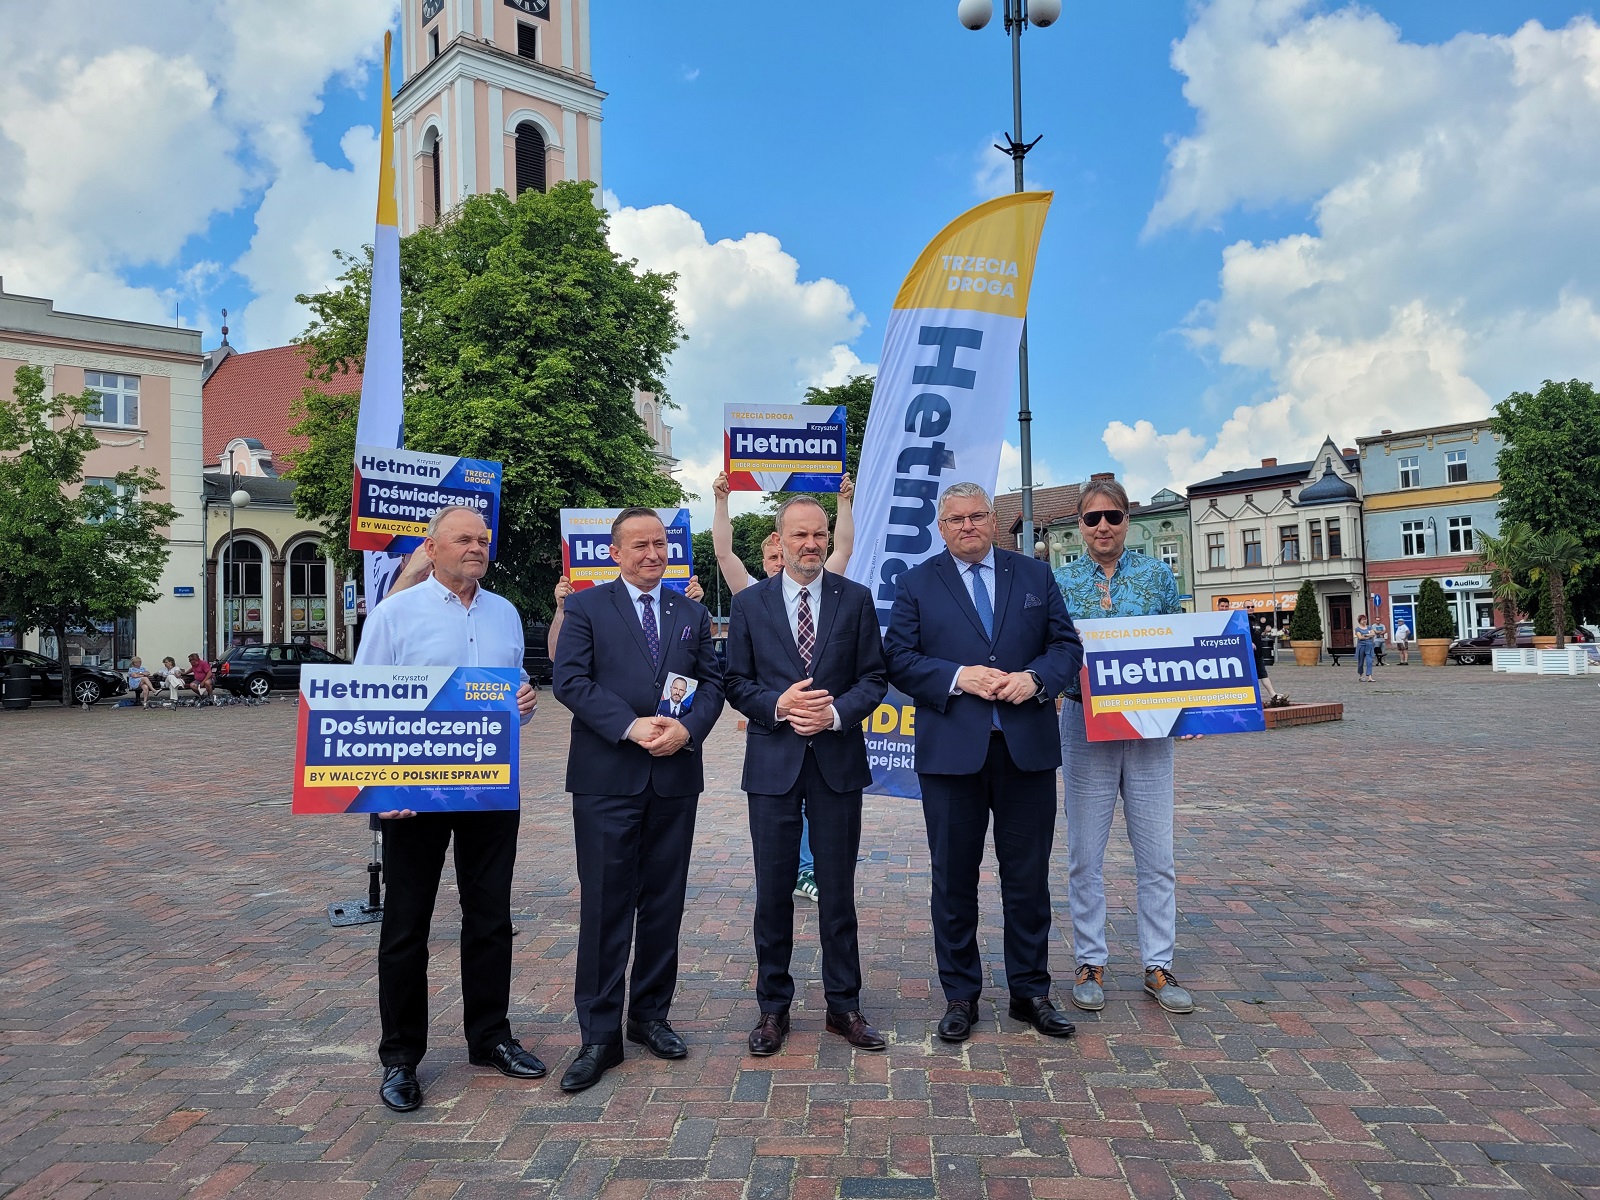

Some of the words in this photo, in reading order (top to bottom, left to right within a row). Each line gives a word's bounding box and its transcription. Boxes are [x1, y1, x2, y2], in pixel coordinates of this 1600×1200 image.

[942, 256, 1018, 277] TRZECIA
[948, 277, 1015, 298] DROGA
[811, 424, 838, 432] Krzysztof
[736, 434, 836, 454] Hetman
[362, 456, 441, 478] Hetman
[416, 458, 441, 466] Krzysztof
[464, 476, 491, 485] DROGA
[465, 470, 495, 480] TRZECIA
[875, 326, 983, 627] Hetma
[368, 484, 488, 509] Doświadczenie
[371, 499, 375, 513] i
[378, 500, 442, 520] kompet
[360, 522, 371, 530] BY
[374, 522, 412, 533] WALCZYĆ
[569, 517, 603, 525] TRZECIA
[1085, 628, 1131, 640] TRZECIA
[1133, 626, 1173, 637] DROGA
[1200, 636, 1240, 647] Krzysztof
[1096, 656, 1244, 686] Hetman
[392, 675, 429, 683] Krzysztof
[310, 679, 428, 699] Hetman
[466, 682, 511, 692] TRZECIA
[466, 691, 505, 701] DROGA
[1099, 699, 1120, 708] LIDER
[1124, 698, 1134, 706] do
[1136, 696, 1186, 705] Parlamentu
[1188, 692, 1248, 702] Europejskiego
[320, 715, 502, 735] Doświadczenie
[324, 738, 331, 758] i
[336, 738, 497, 762] kompetencje
[310, 772, 325, 781] BY
[330, 769, 387, 781] WALCZYĆ
[391, 771, 399, 780] O
[403, 771, 449, 780] POLSKIE
[451, 770, 499, 780] SPRAWY
